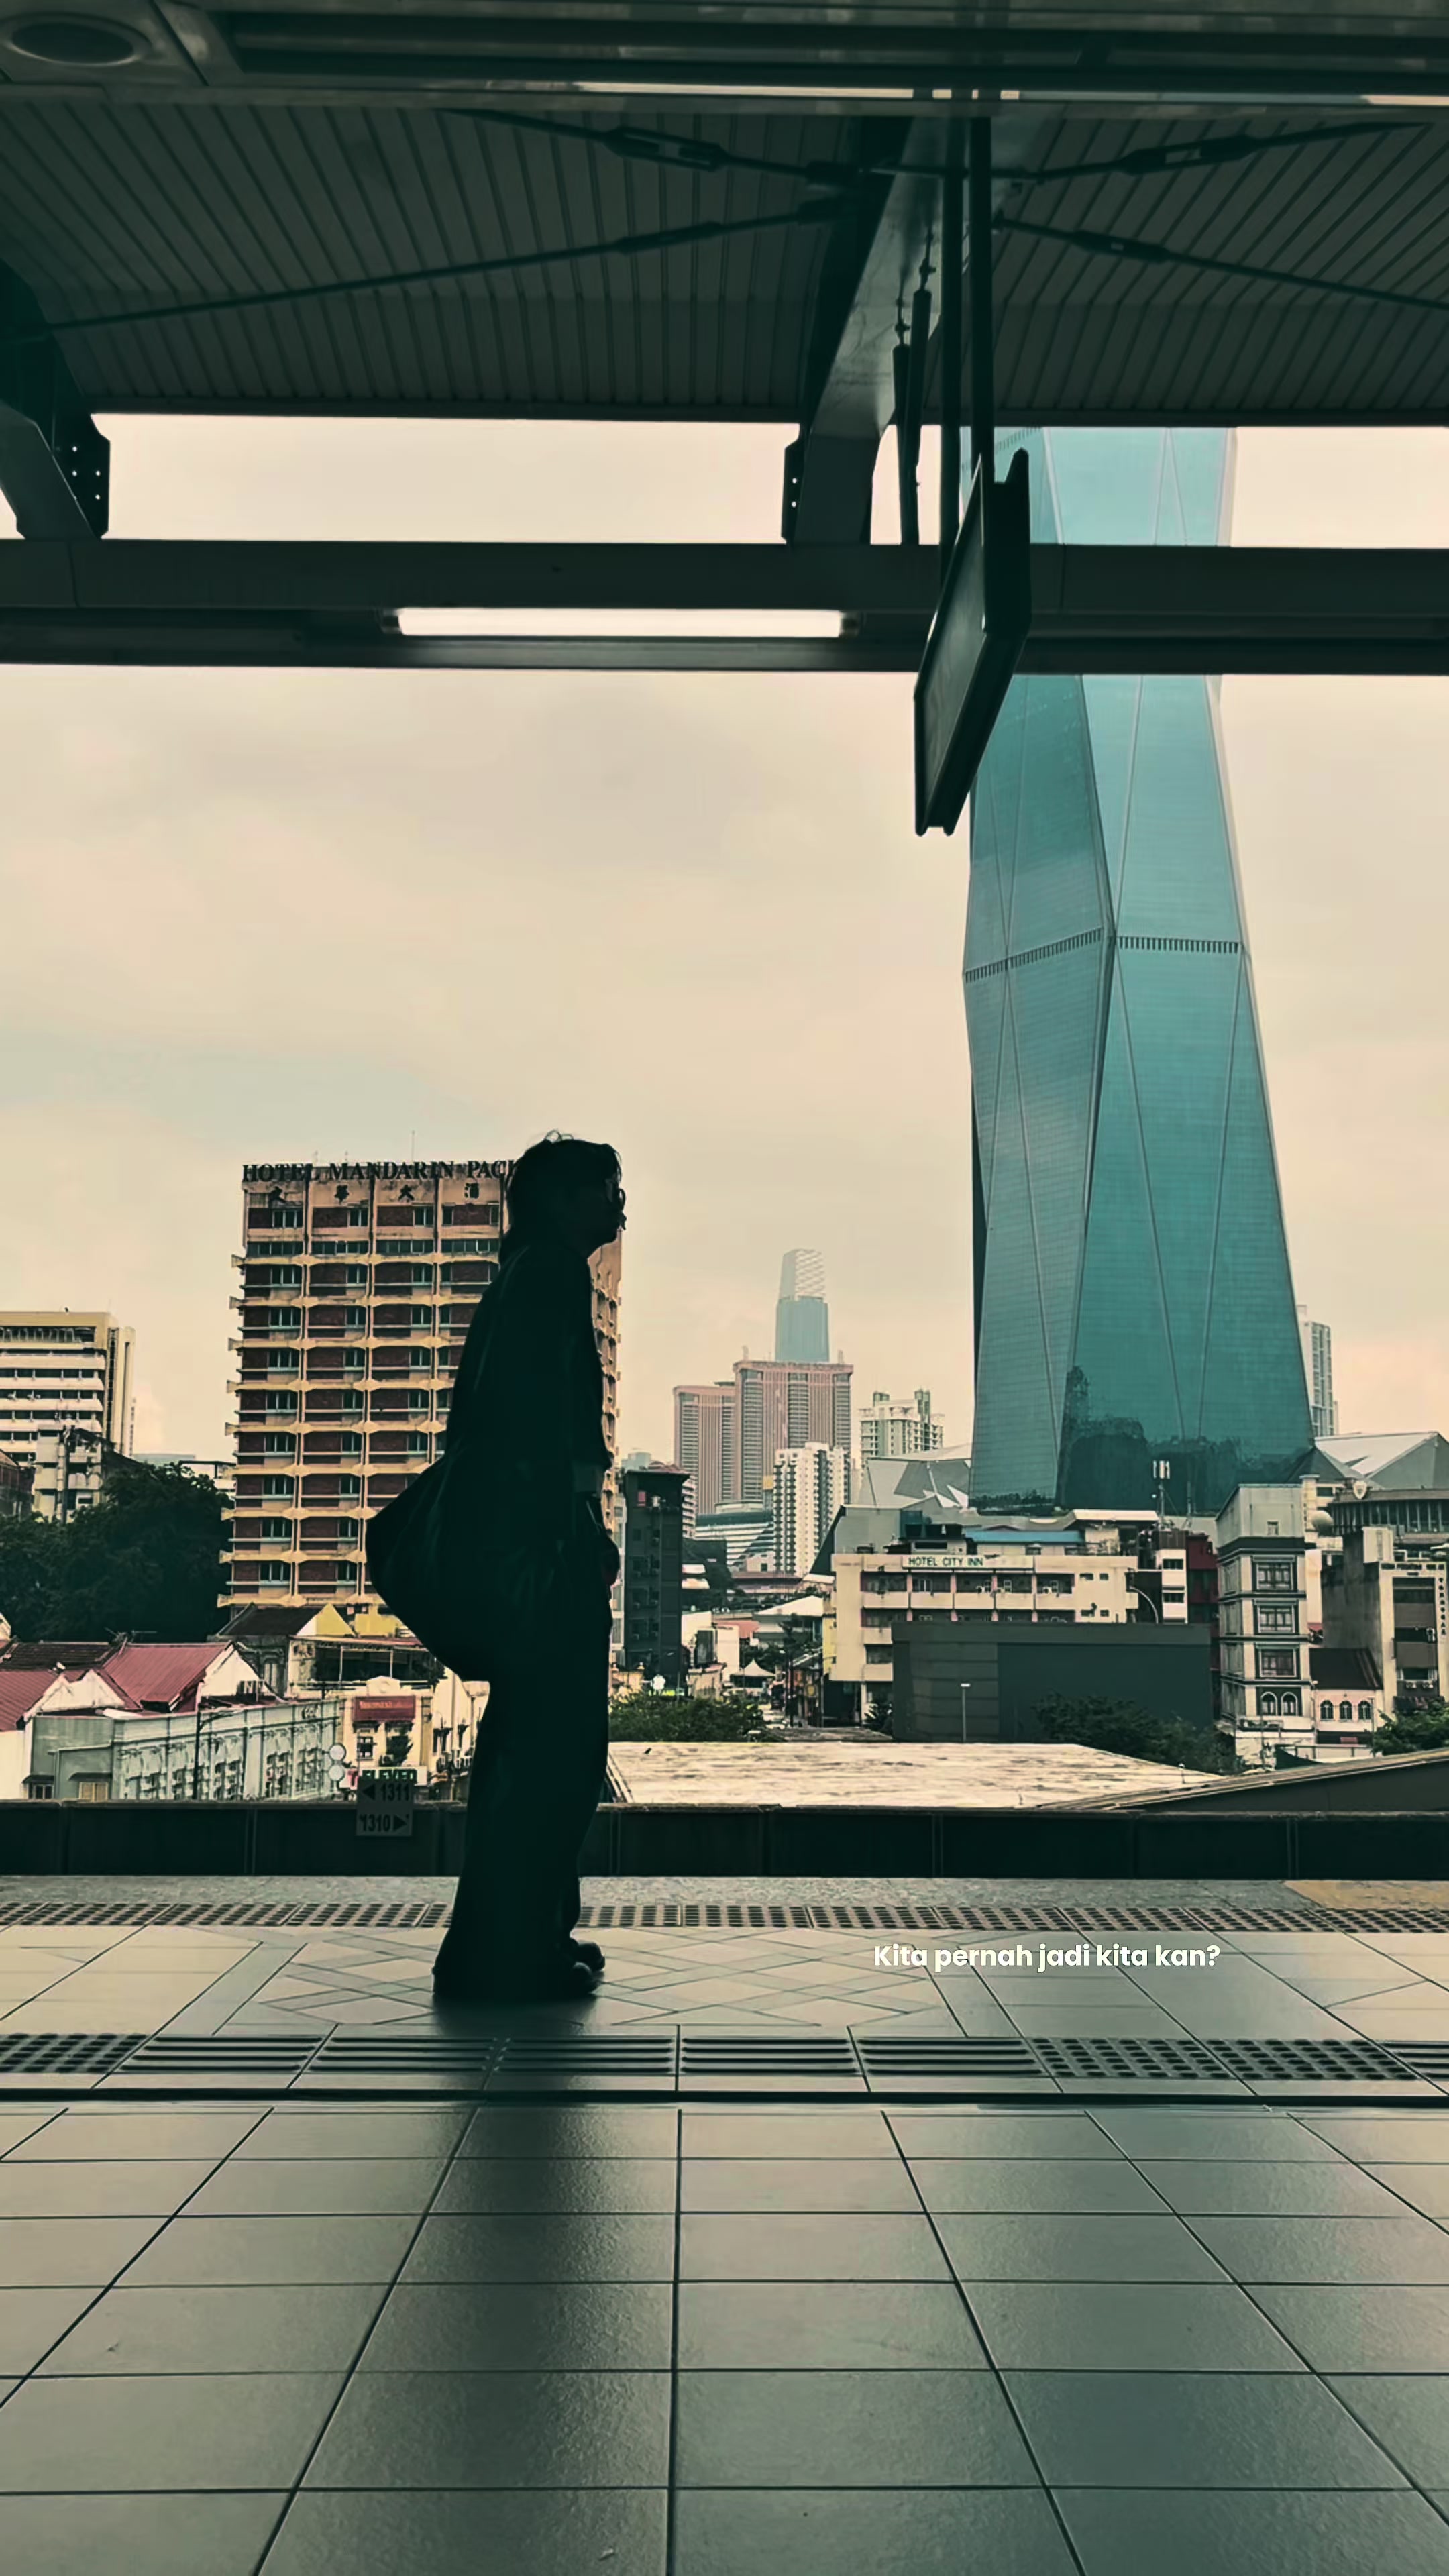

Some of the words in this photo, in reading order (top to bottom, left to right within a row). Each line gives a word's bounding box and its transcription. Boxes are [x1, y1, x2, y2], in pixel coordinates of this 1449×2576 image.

[242, 1163, 321, 1182] HOTEL
[329, 1161, 454, 1180] MANDARIN
[908, 1556, 938, 1566] HOTEL
[943, 1556, 964, 1566] CITY
[967, 1556, 983, 1566] INN
[380, 1782, 410, 1801] 1311
[360, 1813, 391, 1832] 1310
